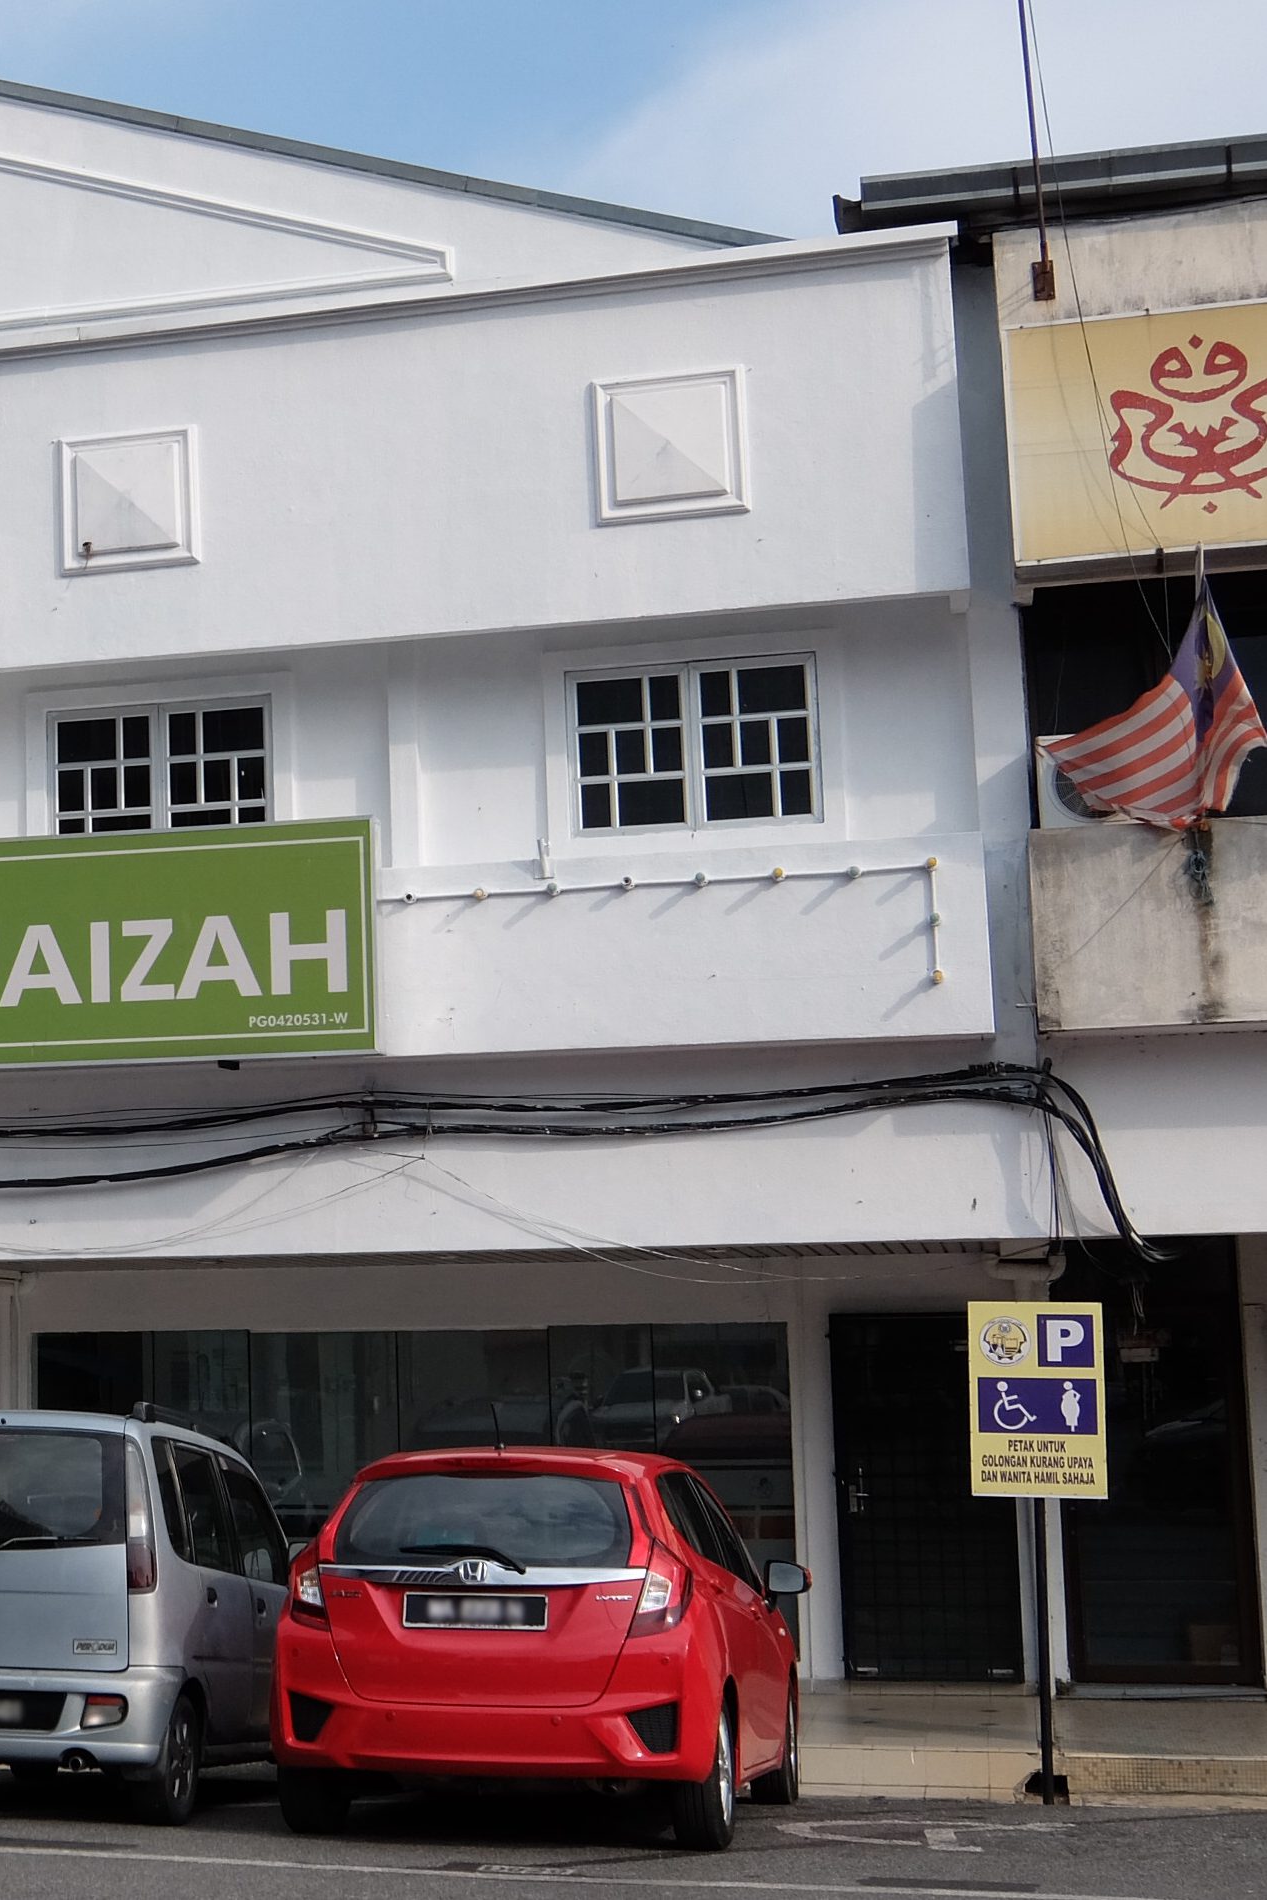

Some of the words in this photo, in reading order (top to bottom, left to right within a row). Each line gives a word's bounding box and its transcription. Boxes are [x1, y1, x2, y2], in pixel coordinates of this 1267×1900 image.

[248, 1012, 348, 1028] PG0420531-W
[1046, 1319, 1085, 1362] P
[1008, 1440, 1034, 1452] PETAK
[1036, 1441, 1066, 1453] UNTUK
[982, 1455, 1028, 1468] GOLONGAN
[1030, 1456, 1065, 1468] KURANG
[1067, 1457, 1094, 1469] UPAYA
[981, 1471, 998, 1482] DAN
[1000, 1471, 1032, 1483] WANITA
[1034, 1472, 1060, 1484] HAMIL
[1062, 1472, 1095, 1485] SAHAJA
